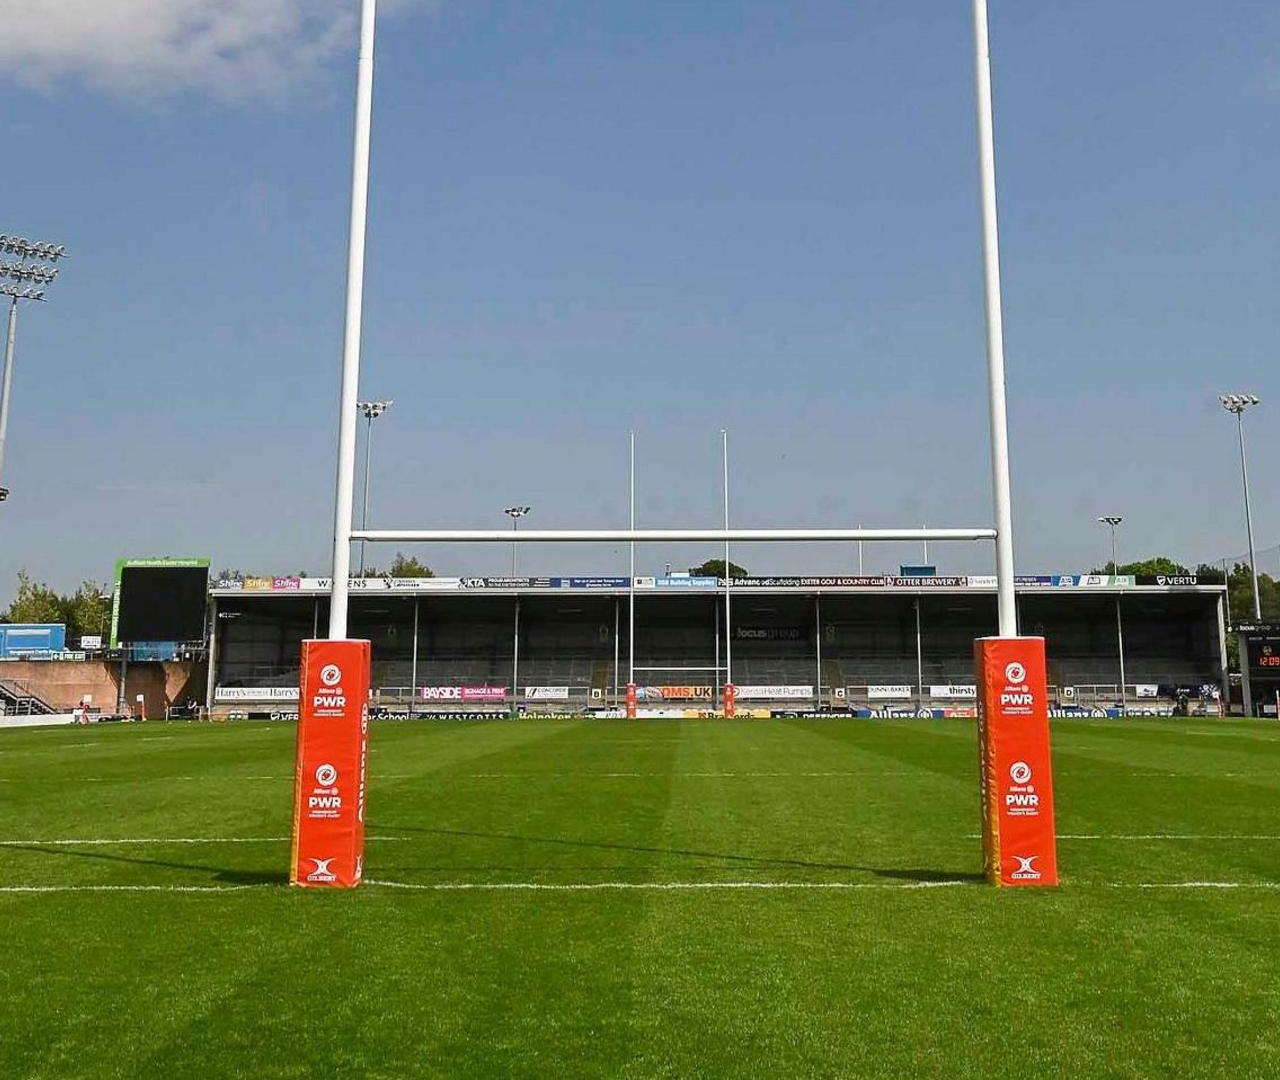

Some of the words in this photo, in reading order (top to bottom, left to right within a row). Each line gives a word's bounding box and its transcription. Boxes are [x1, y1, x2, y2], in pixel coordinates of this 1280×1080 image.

[821, 578, 836, 586] GOLF
[842, 578, 869, 586] COUNTRY
[870, 578, 884, 586] CLUB
[896, 578, 920, 587] OTTER
[921, 578, 957, 587] BREWERY
[1167, 576, 1197, 585] VERTU
[423, 687, 461, 699] BAYSIDE
[948, 687, 976, 697] thirsty
[313, 696, 346, 707] PWR
[1001, 694, 1034, 705] PWR
[870, 708, 916, 718] Allianz
[308, 796, 342, 808] PWR
[1006, 794, 1039, 806] PWR
